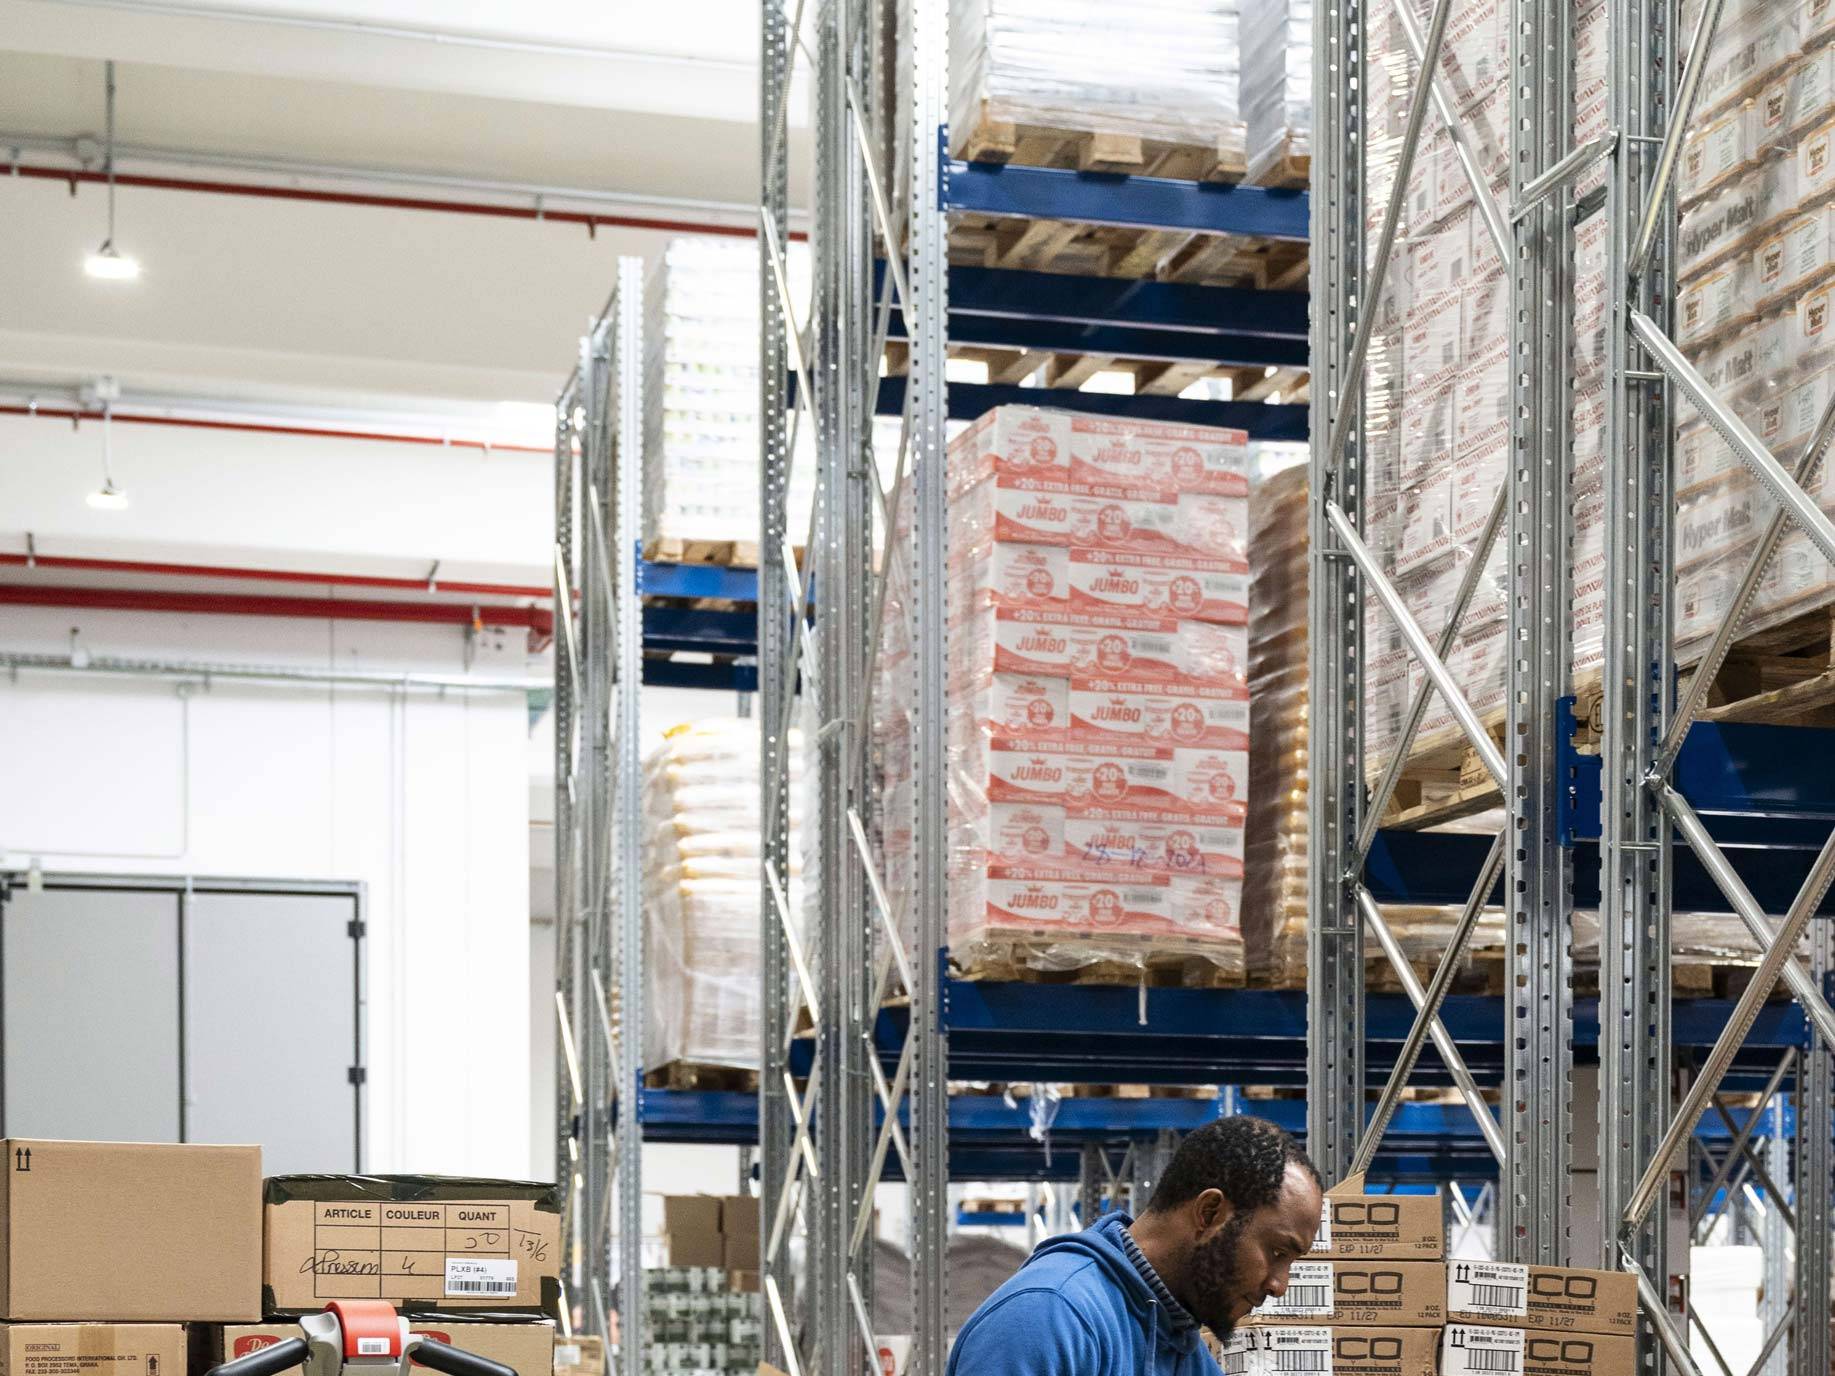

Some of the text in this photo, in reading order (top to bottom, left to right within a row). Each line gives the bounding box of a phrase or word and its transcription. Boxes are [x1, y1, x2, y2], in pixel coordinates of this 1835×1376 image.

[1091, 449, 1142, 465] JUMBO
[1016, 505, 1068, 522] JUMBO
[1089, 578, 1139, 595] JUMBO
[1016, 637, 1067, 653] JUMBO
[1091, 706, 1141, 723] JUMBO
[1010, 766, 1062, 783] JUMBO
[1088, 834, 1135, 850] JUMBO
[1007, 893, 1058, 910] JUMBO
[324, 1209, 496, 1222] ARTICLE COULEUR QUANT
[1330, 1203, 1400, 1225] CO
[1339, 1244, 1383, 1254] EXP 11/27
[1528, 1273, 1597, 1299] CO
[1327, 1311, 1378, 1321] EXP 11/27
[1528, 1316, 1544, 1325] EXP
[1550, 1317, 1574, 1327] 11/27
